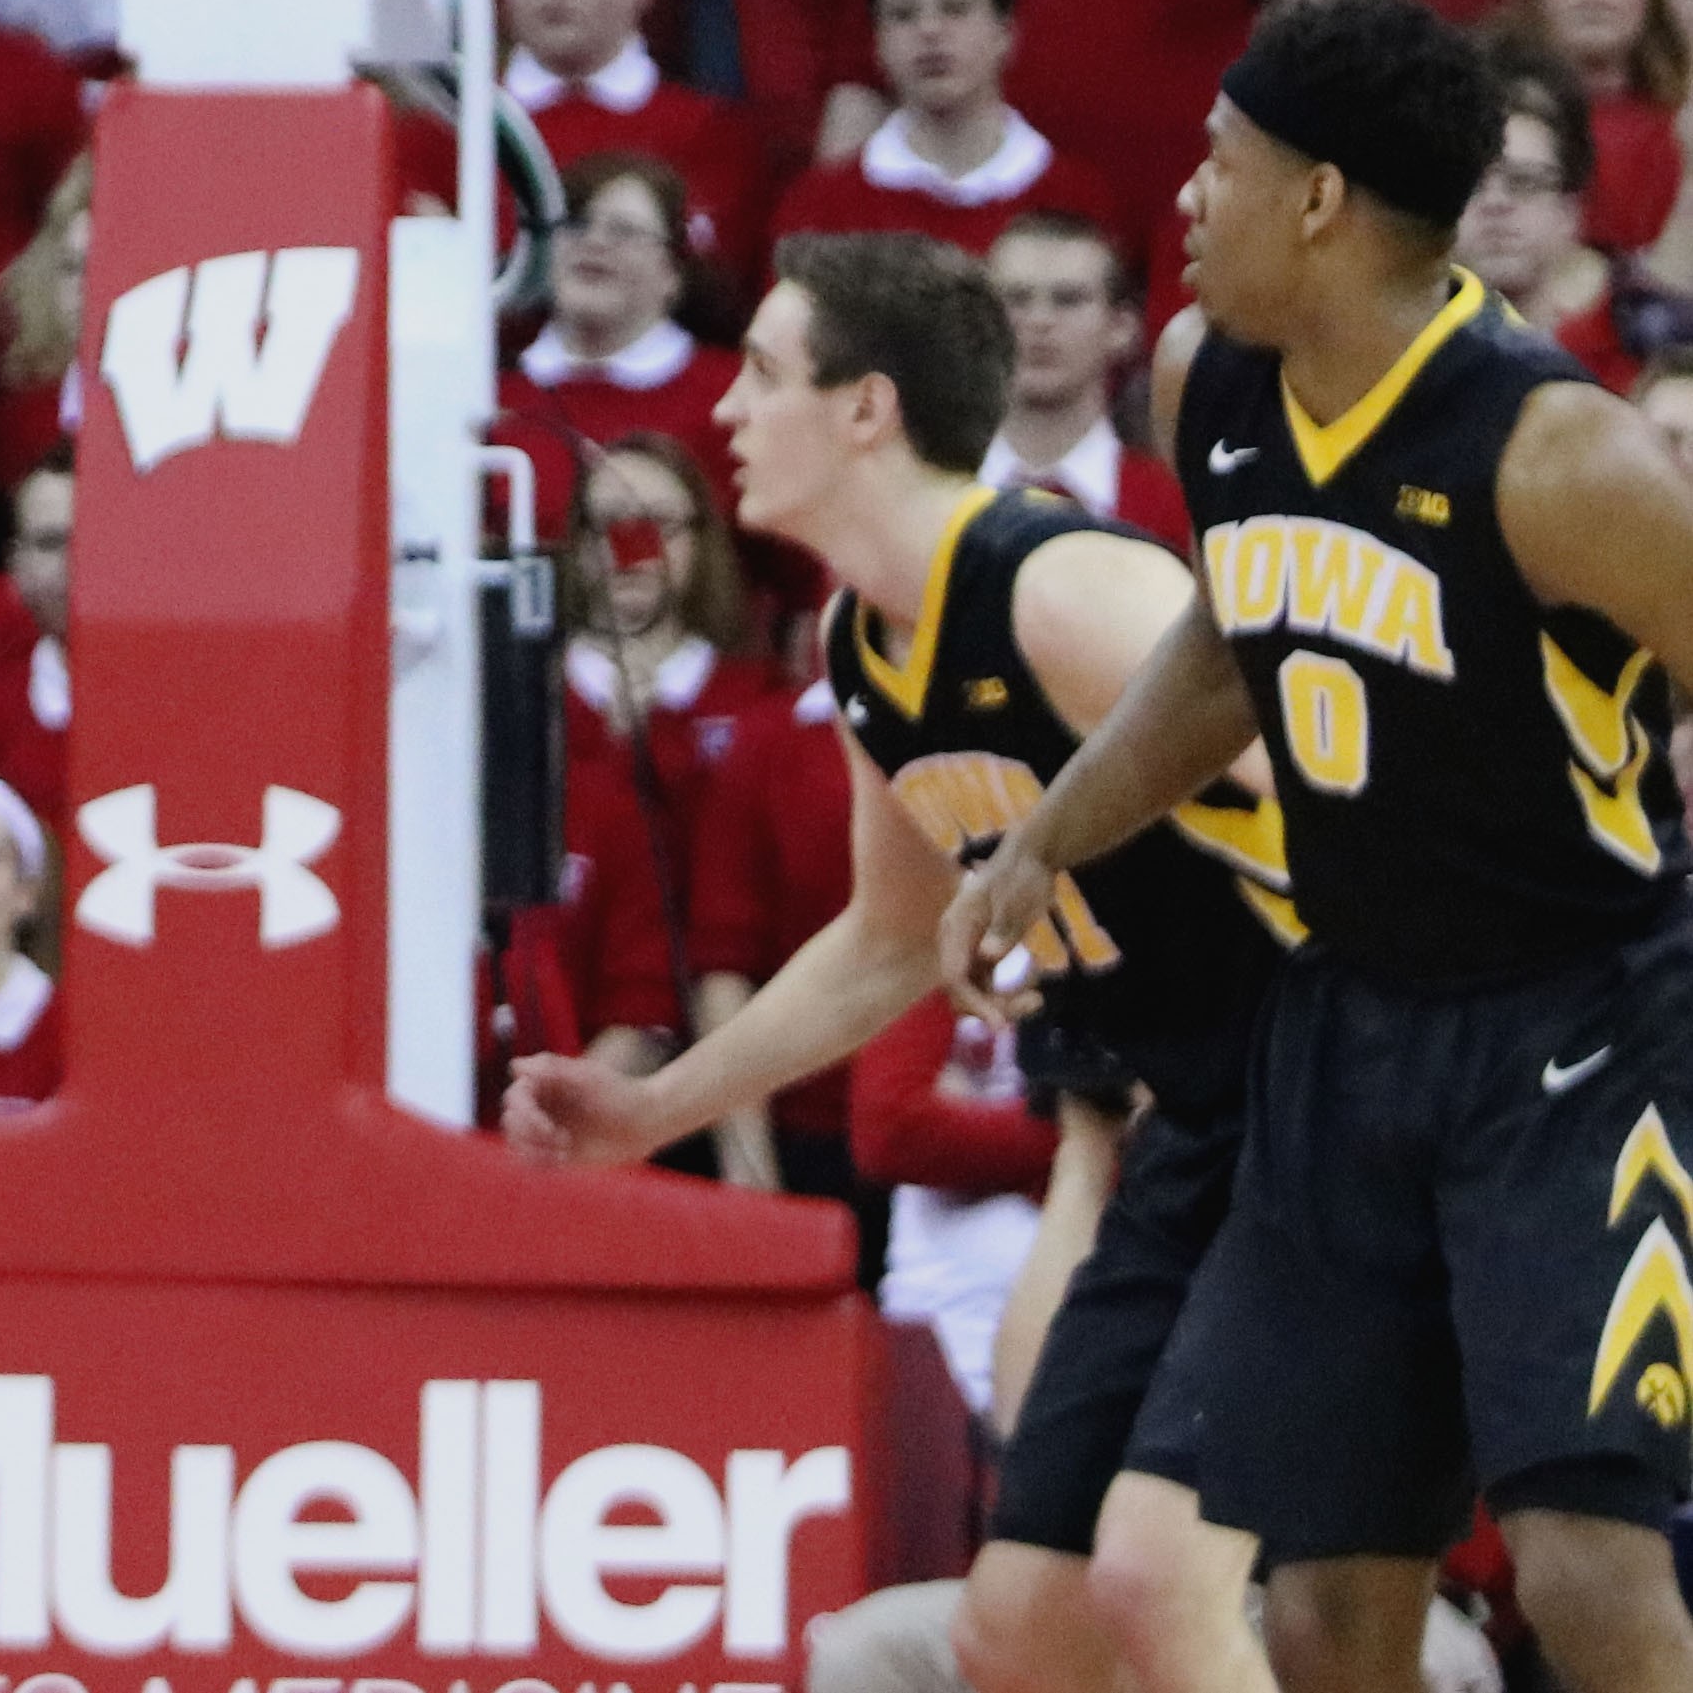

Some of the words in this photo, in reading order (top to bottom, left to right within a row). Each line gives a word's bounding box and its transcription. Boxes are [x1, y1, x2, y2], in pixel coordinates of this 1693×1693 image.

[100, 245, 360, 476] W
[1203, 514, 1457, 682] IOWA
[1279, 648, 1370, 797] 0
